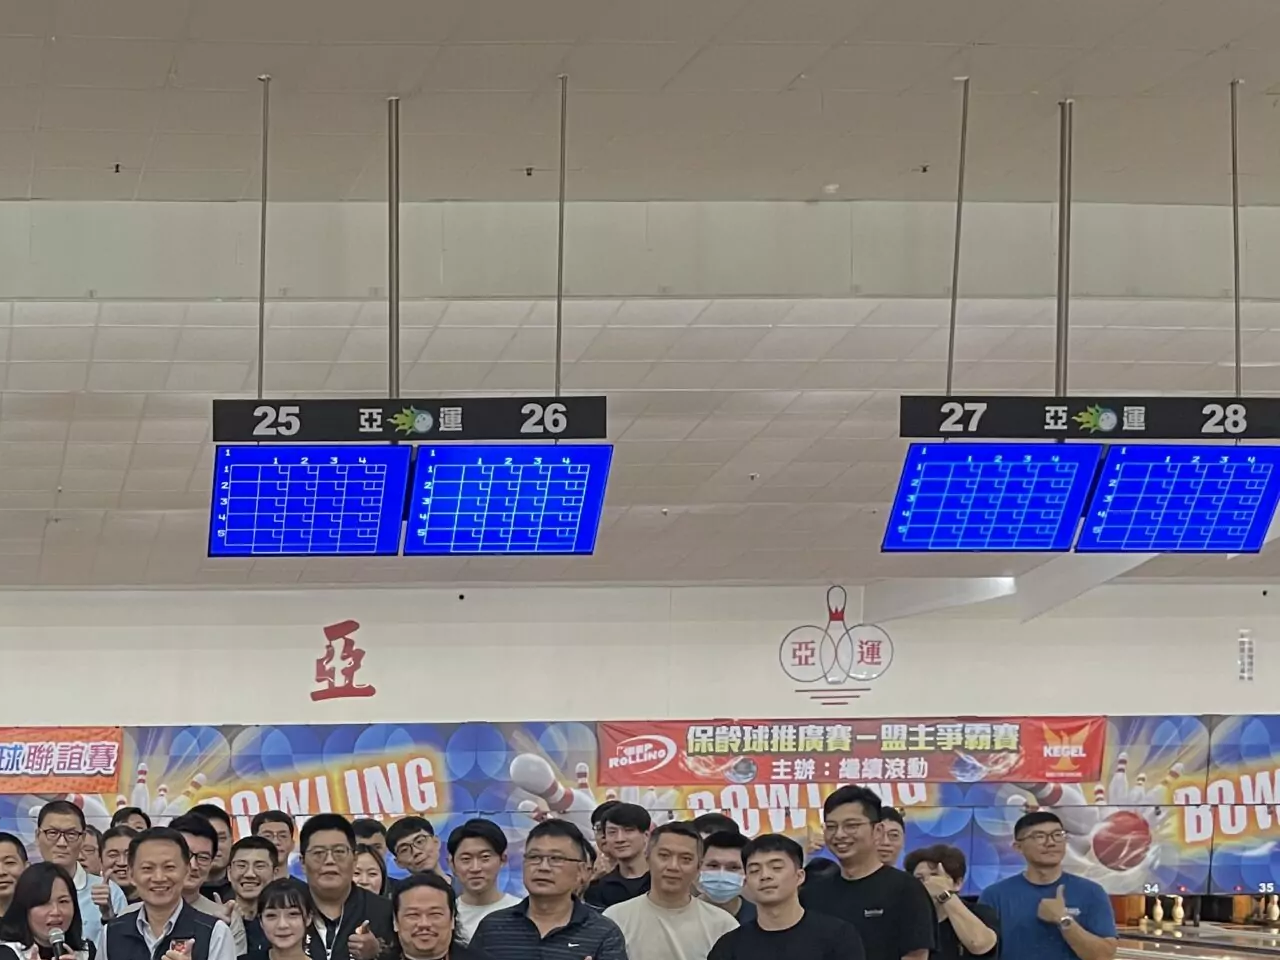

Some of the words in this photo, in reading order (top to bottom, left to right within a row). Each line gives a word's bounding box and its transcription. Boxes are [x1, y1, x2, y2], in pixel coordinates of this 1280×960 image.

[252, 406, 300, 435] 25
[520, 403, 567, 433] 26
[939, 403, 987, 432] 27
[1201, 404, 1247, 433] 28
[310, 619, 376, 701] 亞
[791, 640, 816, 666] 亞
[857, 640, 883, 666] 運
[1044, 744, 1087, 757] KEGEL
[199, 757, 438, 841] OWLING
[1144, 884, 1159, 893] 34
[1259, 883, 1274, 893] 35
